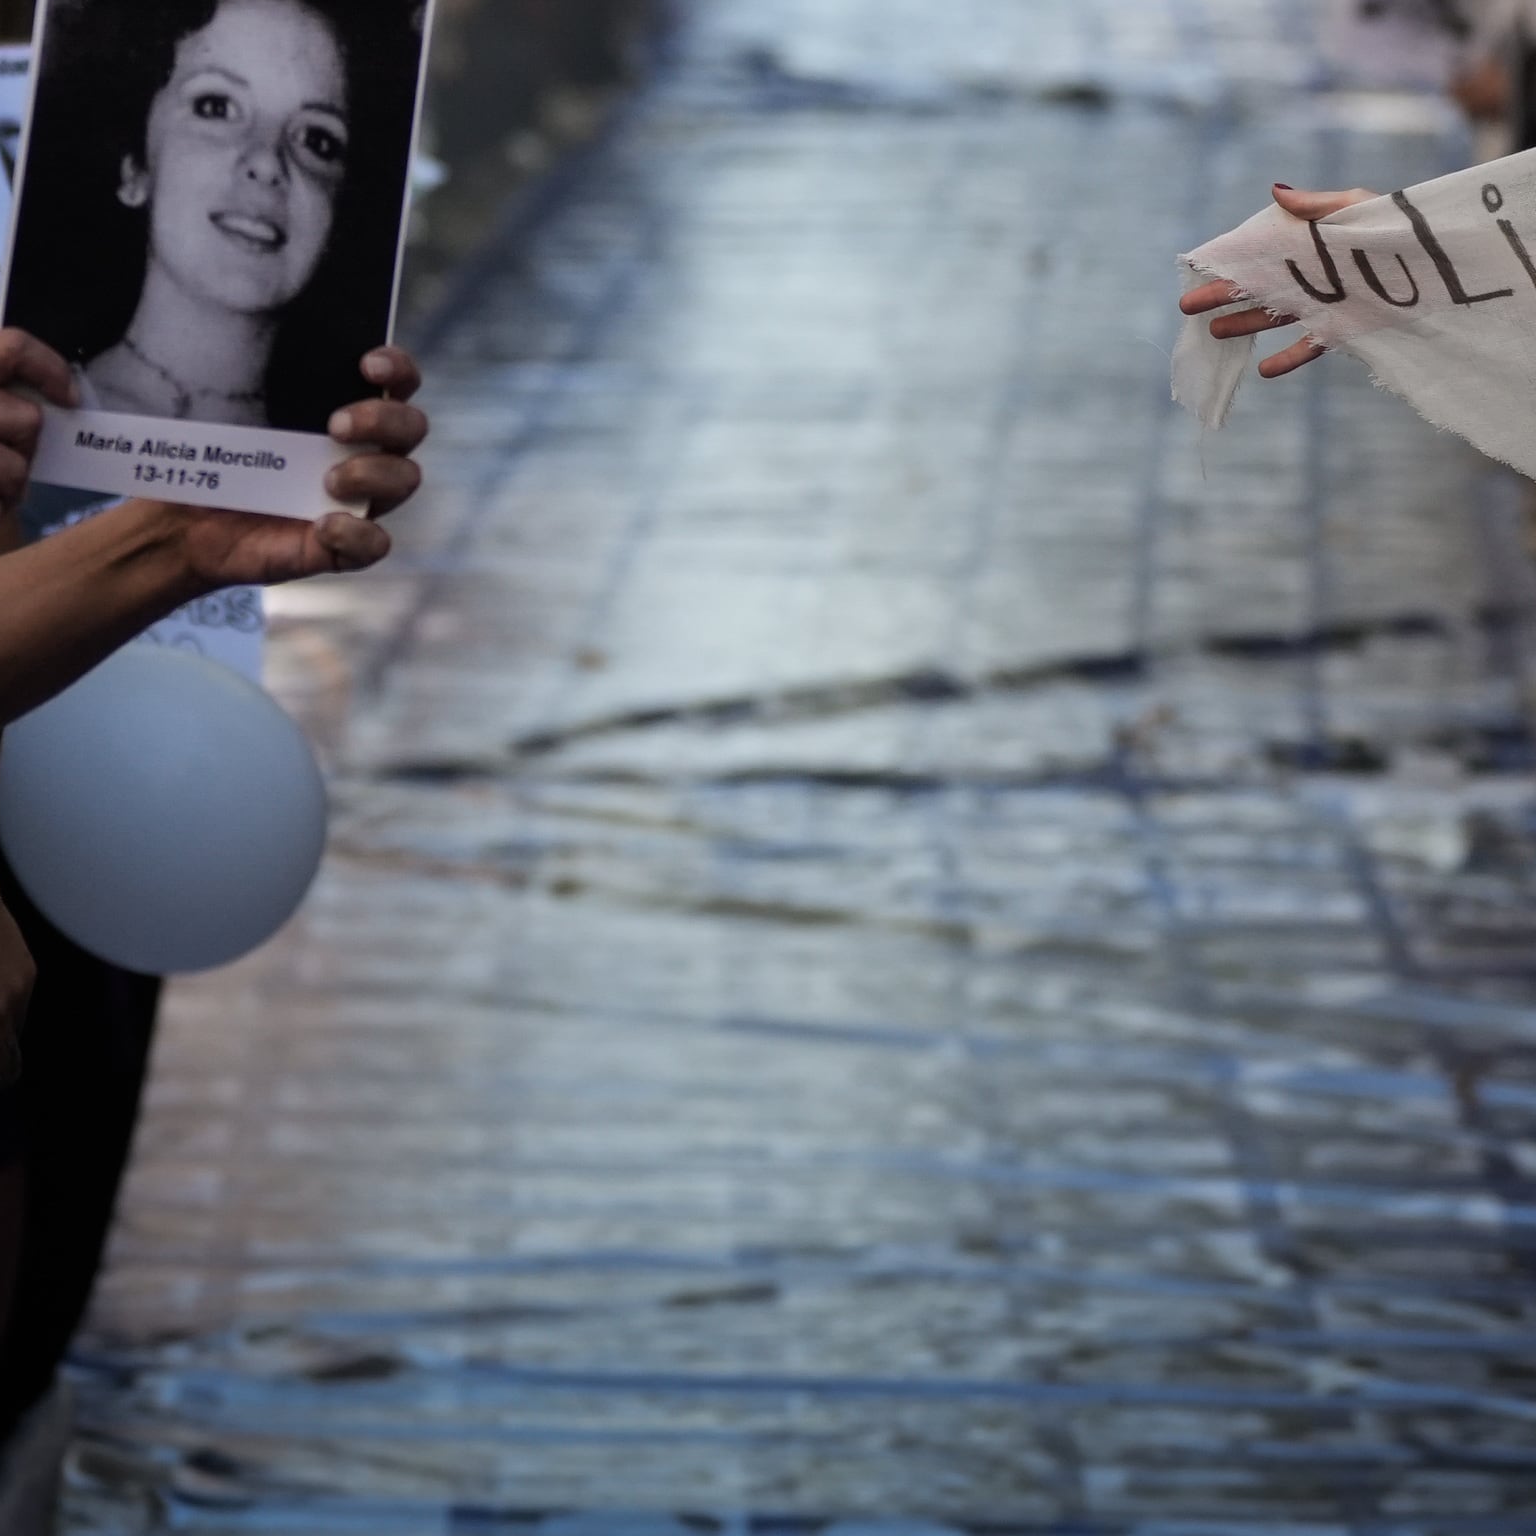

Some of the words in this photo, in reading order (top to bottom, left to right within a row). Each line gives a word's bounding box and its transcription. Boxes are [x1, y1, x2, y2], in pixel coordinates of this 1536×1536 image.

[75, 430, 133, 454] María
[138, 439, 197, 462] Alicia
[202, 445, 287, 470] Morcillo
[133, 463, 220, 490] 13-11-76
